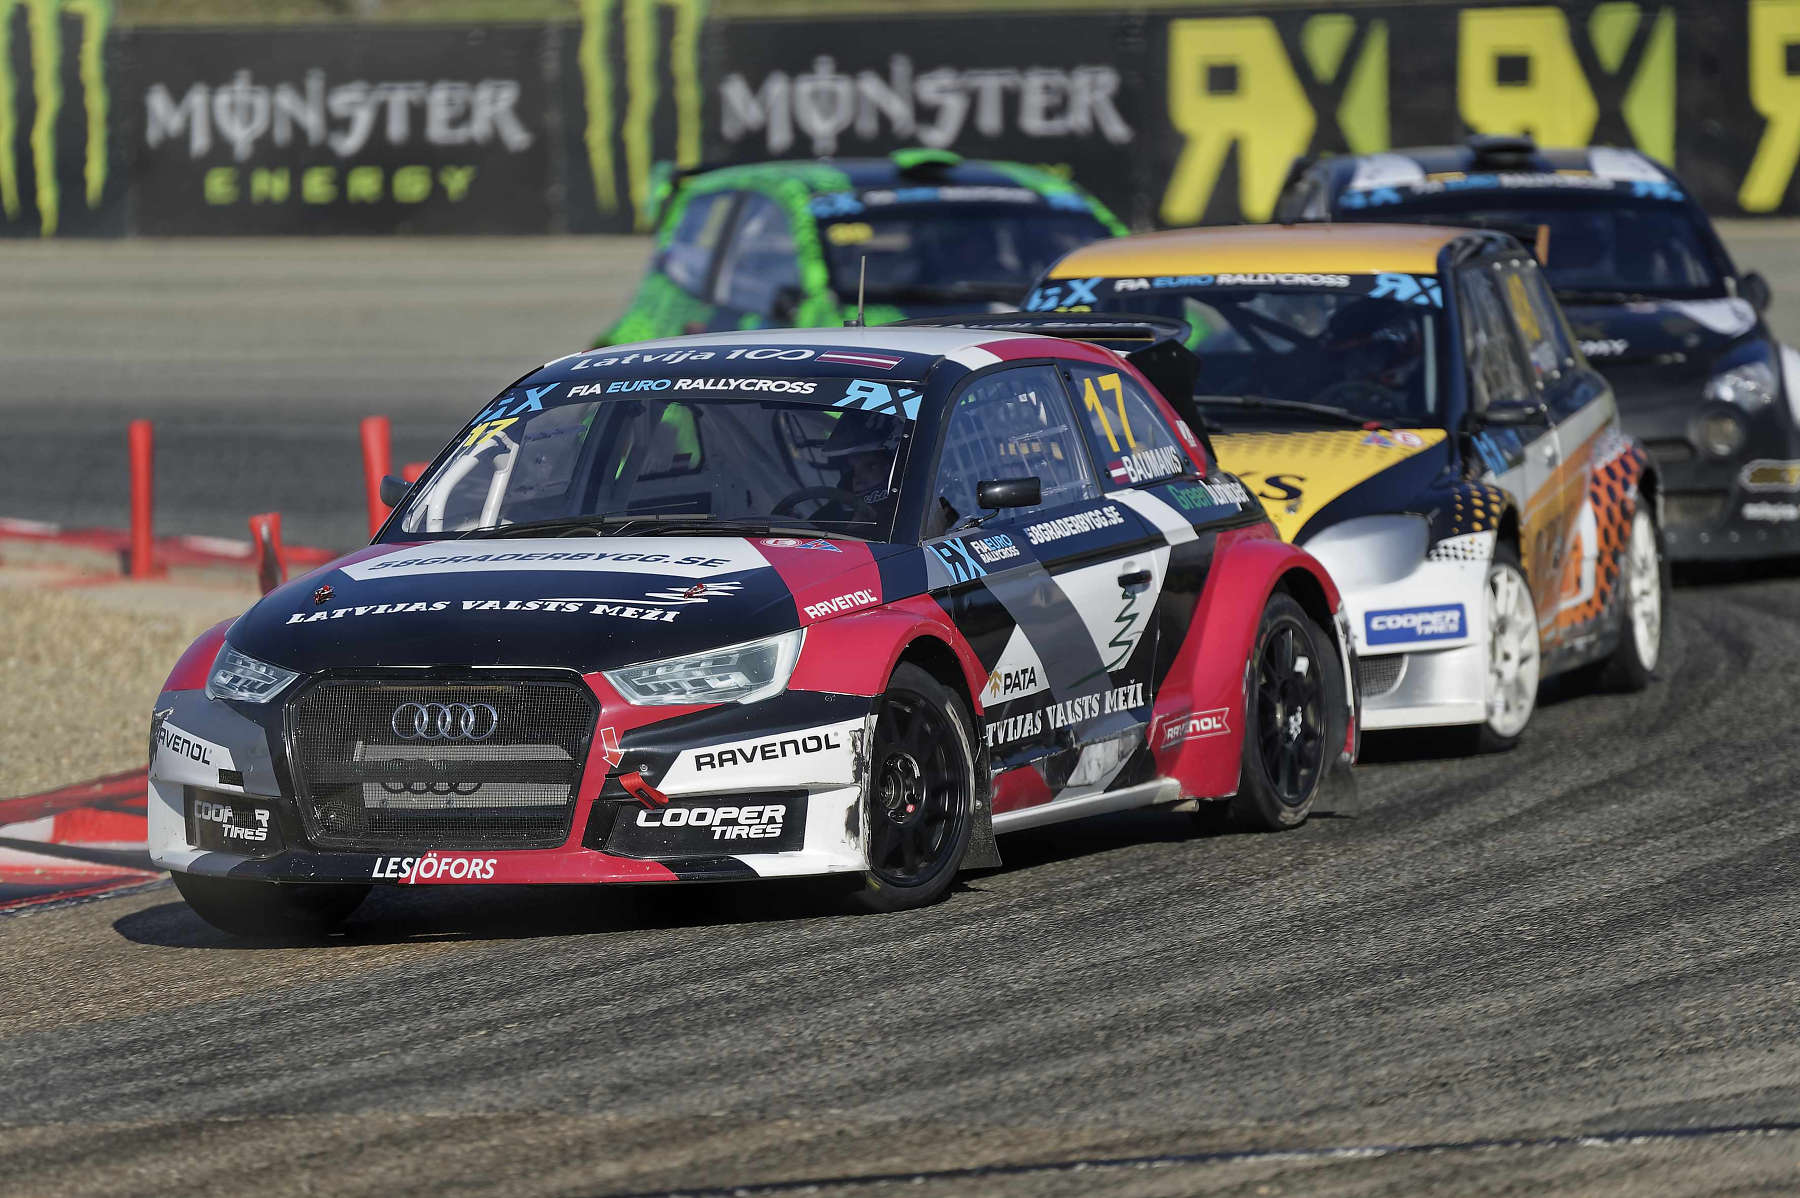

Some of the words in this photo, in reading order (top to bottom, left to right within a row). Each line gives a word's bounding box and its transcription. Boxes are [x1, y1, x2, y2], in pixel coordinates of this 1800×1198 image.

[145, 68, 532, 161] MONSTER
[719, 55, 1134, 155] MONSTER
[203, 165, 476, 204] ENERGY
[1114, 278, 1150, 292] FIA
[1152, 274, 1214, 288] EURO
[1216, 273, 1350, 288] RALLYCROSS
[570, 350, 716, 371] Latvija
[566, 384, 601, 398] FIA
[606, 379, 671, 393] EURO
[673, 378, 818, 395] RALLYCROSS
[1083, 373, 1136, 453] 17
[463, 417, 520, 448] 17
[1120, 445, 1184, 483] BAUMANIS
[1024, 505, 1124, 545] 58GRADERBYGG.SE
[367, 553, 732, 571] 58GRADERBYGG.SE
[285, 600, 452, 625] LATVIJAS
[461, 600, 584, 613] VALSTS
[589, 604, 681, 623] MEŽI
[803, 589, 878, 619] RAVENOL
[1003, 666, 1037, 695] PATA
[1045, 693, 1100, 730] VALSTS
[1104, 679, 1145, 714] MEŽI
[156, 726, 210, 766] AVENOL
[695, 733, 840, 771] RAVENOL
[636, 804, 786, 828] COOPER
[222, 824, 268, 841] TIRES
[710, 823, 782, 840] TIRES
[372, 856, 497, 884] LESJÖFORS
